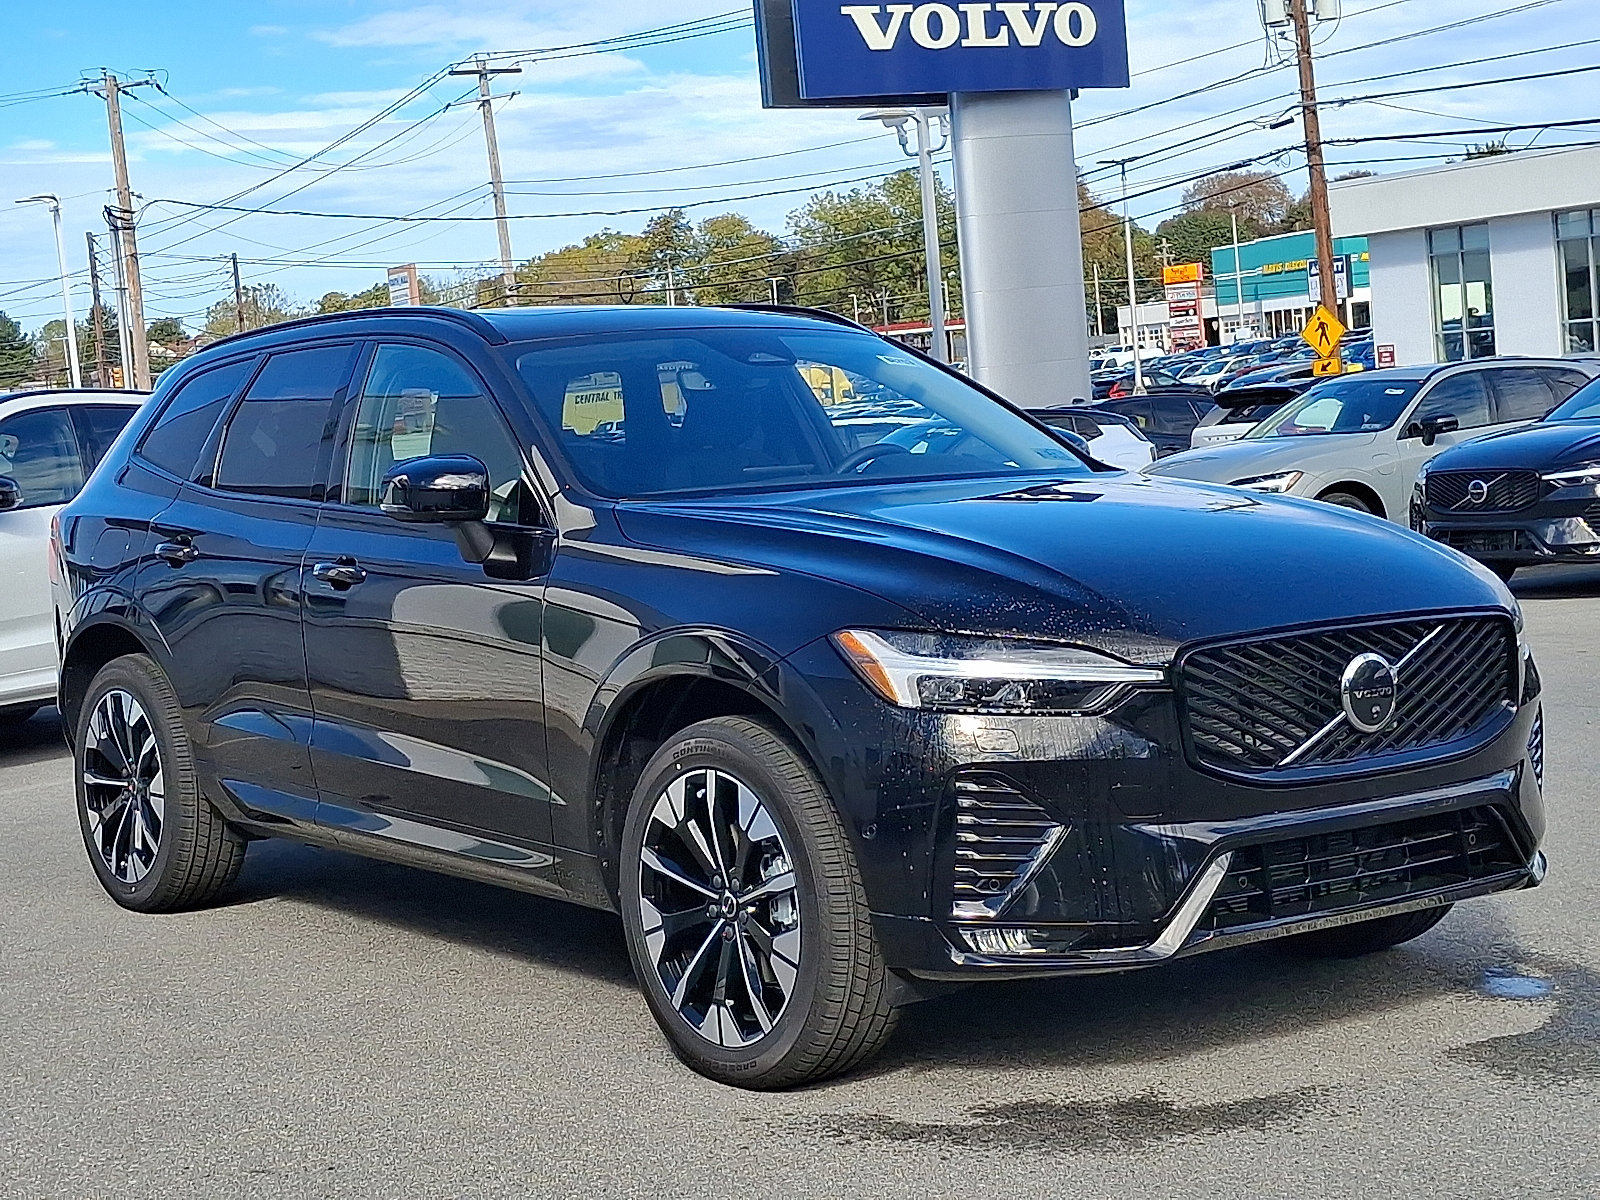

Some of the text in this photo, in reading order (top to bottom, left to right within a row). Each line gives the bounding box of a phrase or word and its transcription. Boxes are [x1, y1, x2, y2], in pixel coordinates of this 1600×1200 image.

[842, 2, 1097, 50] VOLVO
[574, 390, 624, 405] CENTRAL TR
[1354, 687, 1392, 698] VOLVO
